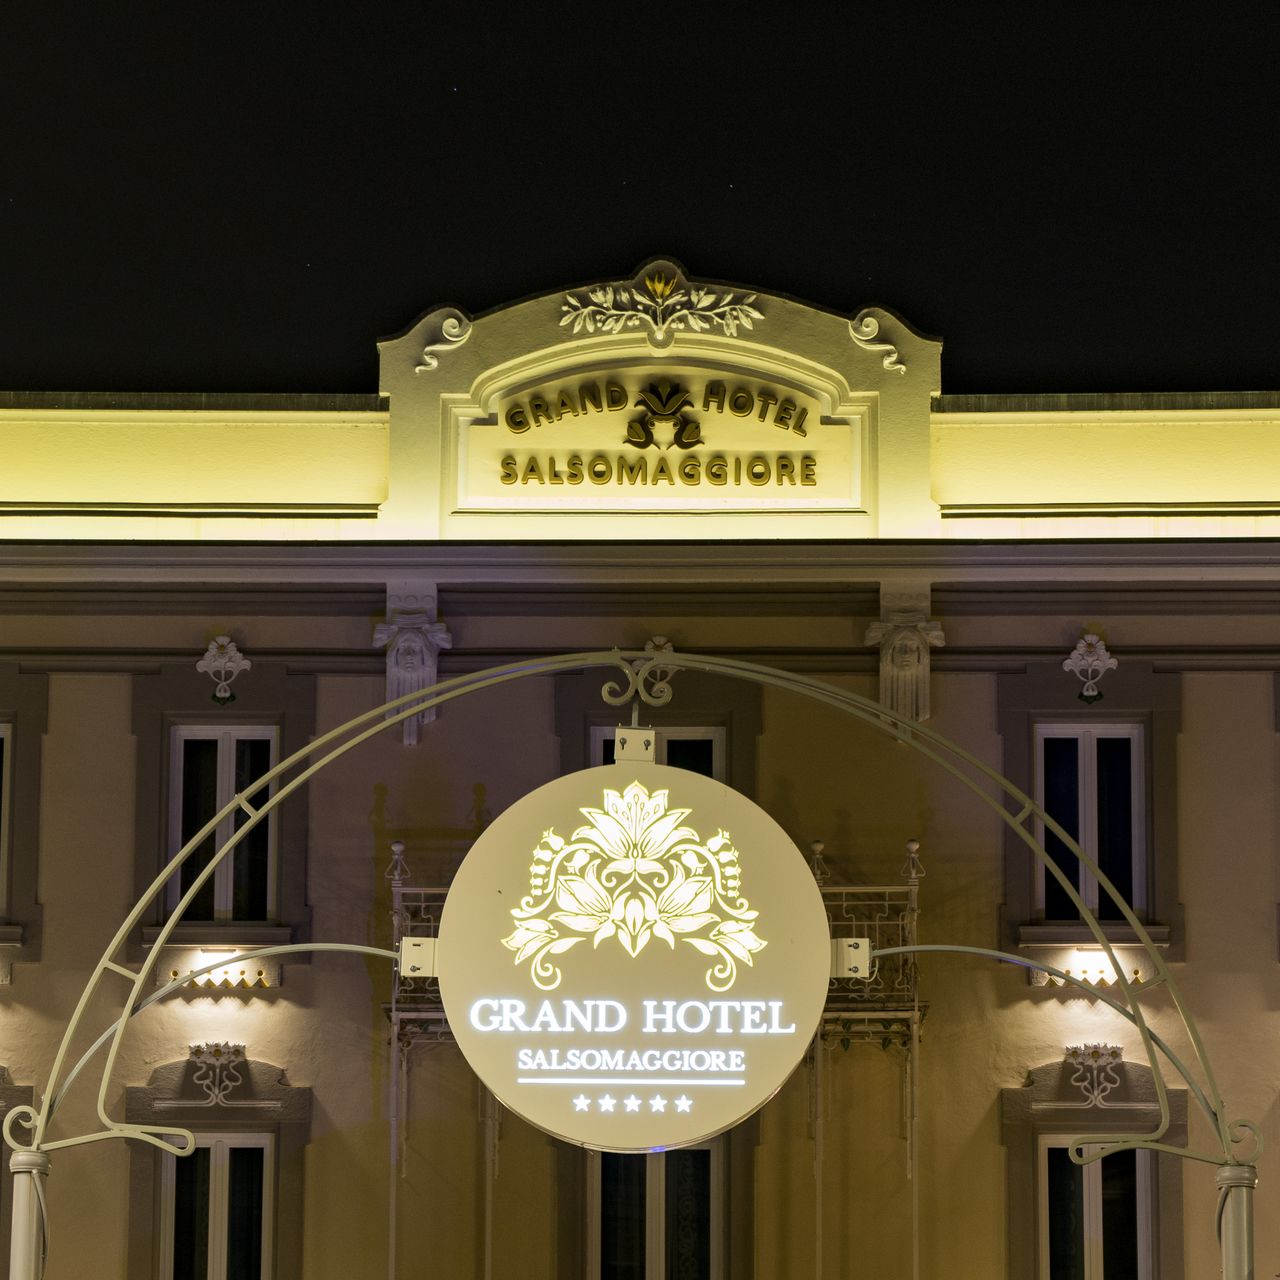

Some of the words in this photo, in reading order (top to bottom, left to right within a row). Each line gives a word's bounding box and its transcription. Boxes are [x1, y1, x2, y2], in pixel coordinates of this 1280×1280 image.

[504, 381, 629, 435] GRAND
[701, 378, 809, 437] HOTEL
[499, 455, 817, 486] SALSOMAGGIORE
[470, 998, 627, 1033] GRAND
[642, 1000, 796, 1034] HOTEL
[517, 1048, 746, 1073] SALSOMAGGIORE
